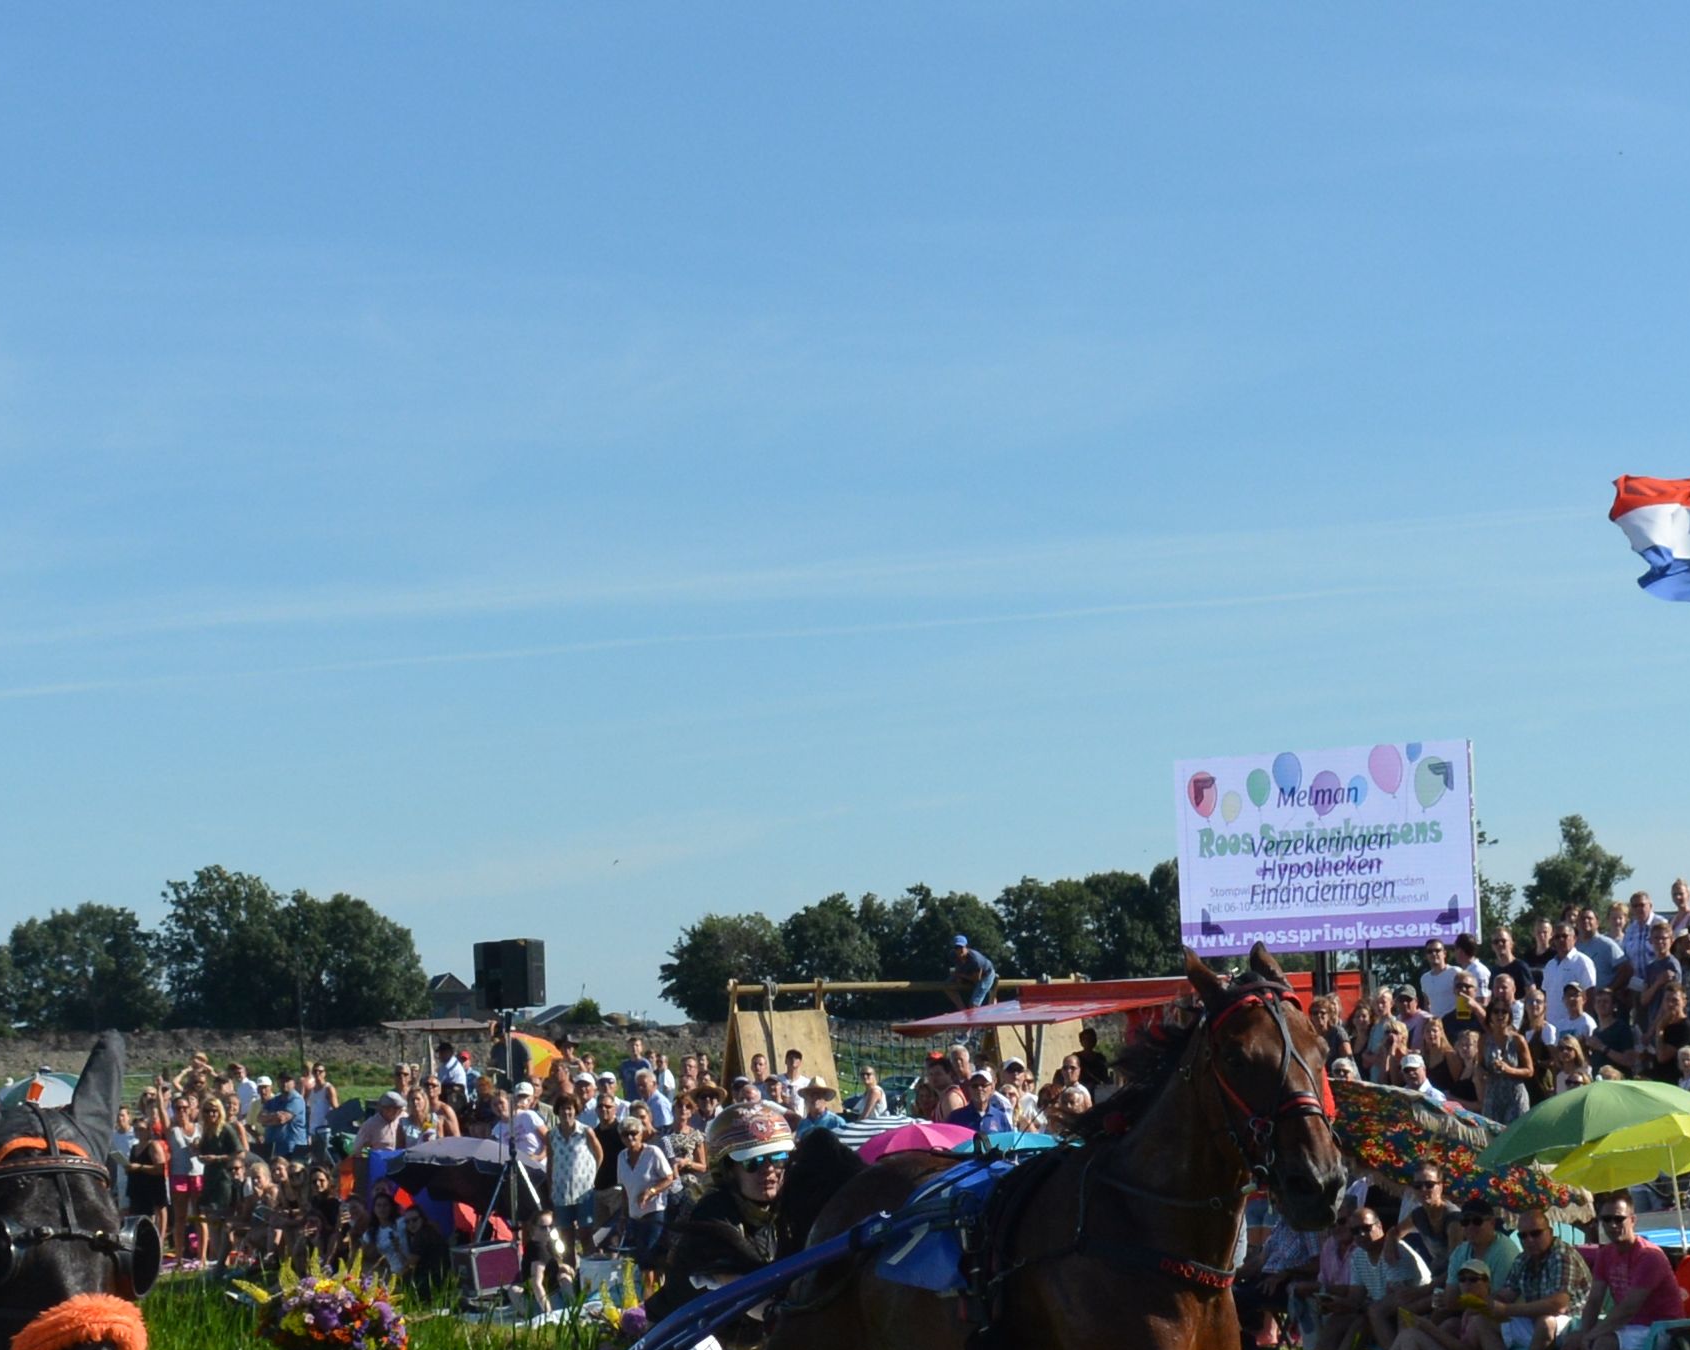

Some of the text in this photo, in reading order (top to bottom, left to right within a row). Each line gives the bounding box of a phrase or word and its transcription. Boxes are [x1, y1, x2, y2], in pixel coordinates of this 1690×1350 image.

[1276, 785, 1358, 809] Melman
[1197, 827, 1252, 859] Roos
[1250, 831, 1392, 860] Verzekeringen
[1261, 856, 1382, 887] Hypotheken
[1249, 879, 1396, 906] Financieringen
